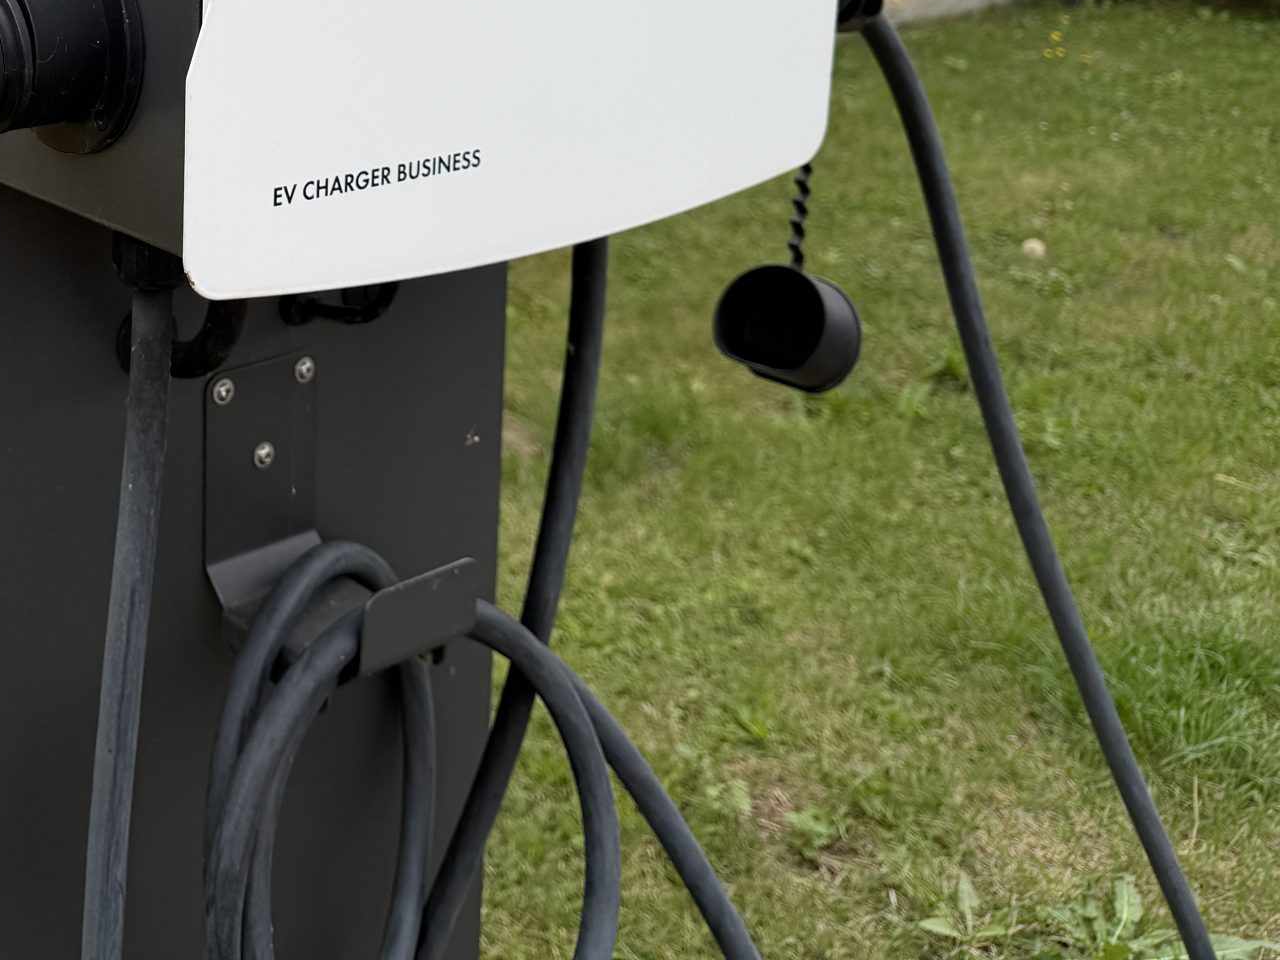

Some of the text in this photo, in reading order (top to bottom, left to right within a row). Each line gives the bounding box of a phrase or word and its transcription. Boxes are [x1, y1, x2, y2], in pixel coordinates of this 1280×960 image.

[273, 149, 481, 206] EV CHARGER BUSINESS
